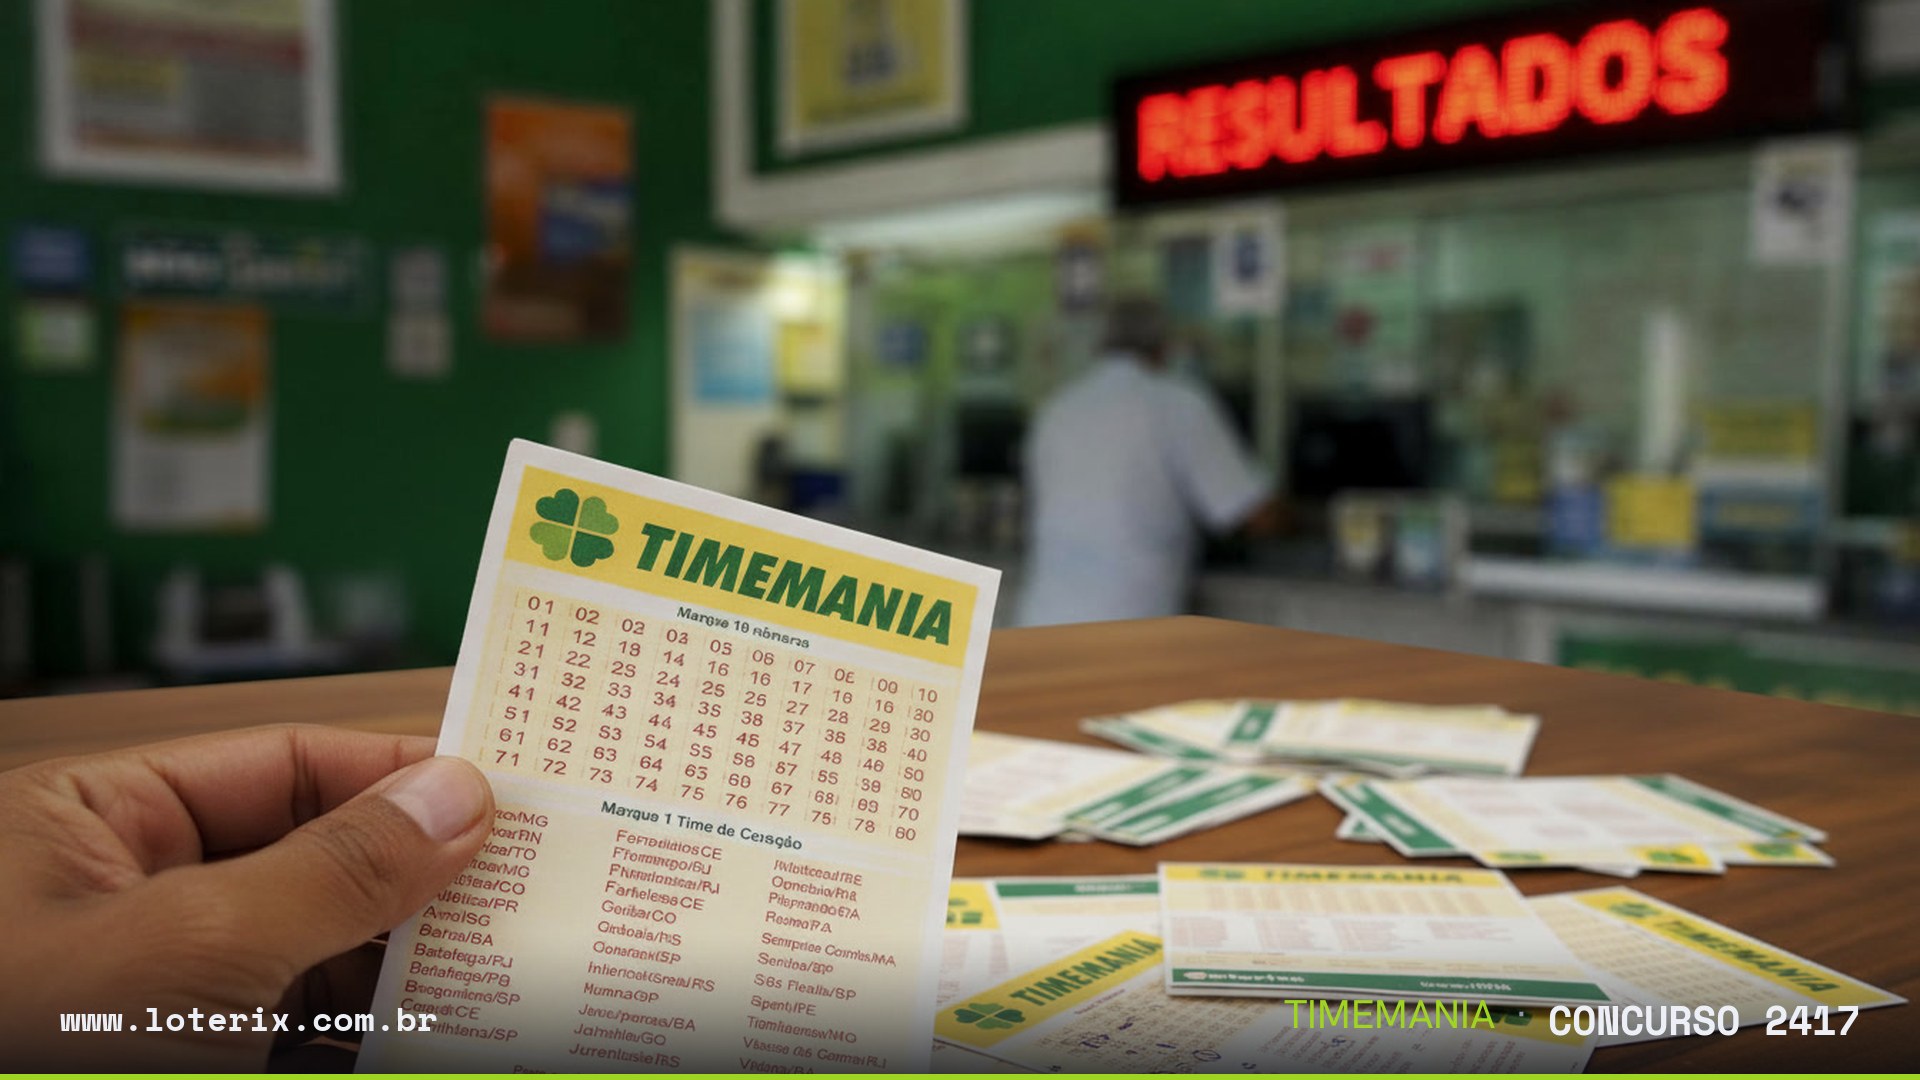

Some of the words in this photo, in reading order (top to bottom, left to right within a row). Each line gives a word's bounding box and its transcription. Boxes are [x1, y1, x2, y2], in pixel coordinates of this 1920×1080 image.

[1137, 6, 1729, 182] RESULTADOS
[637, 522, 952, 646] TIMEMANIA
[517, 640, 544, 659] 21
[565, 651, 591, 669] 22
[656, 671, 680, 688] 24
[786, 700, 809, 715] 27
[526, 619, 549, 637] 11
[573, 630, 596, 647] 12
[664, 650, 685, 667] 14
[708, 661, 729, 676] 16
[792, 681, 812, 695] 17
[528, 596, 553, 615] 01
[575, 607, 600, 625] 02
[794, 660, 816, 675] 07
[919, 688, 937, 703] 10
[508, 684, 535, 701] 41
[556, 695, 581, 712] 42
[601, 704, 627, 719] 43
[693, 723, 717, 739] 45
[778, 741, 802, 756] 47
[514, 662, 539, 680] 31
[561, 672, 586, 690] 32
[607, 682, 631, 699] 33
[653, 692, 676, 708] 34
[783, 720, 805, 735] 37
[496, 750, 519, 766] 71
[543, 758, 566, 775] 72
[590, 767, 613, 783] 73
[636, 775, 657, 792] 74
[682, 784, 704, 800] 75
[726, 793, 747, 809] 76
[768, 801, 790, 816] 77
[499, 728, 524, 745] 61
[547, 738, 572, 754] 62
[593, 746, 617, 762] 63
[640, 756, 662, 772] 64
[771, 781, 793, 796] 67
[899, 805, 919, 821] 70
[664, 813, 671, 825] 1
[677, 815, 713, 833] Time
[716, 824, 735, 837] de
[1010, 938, 1163, 1006] TIMEMANIA
